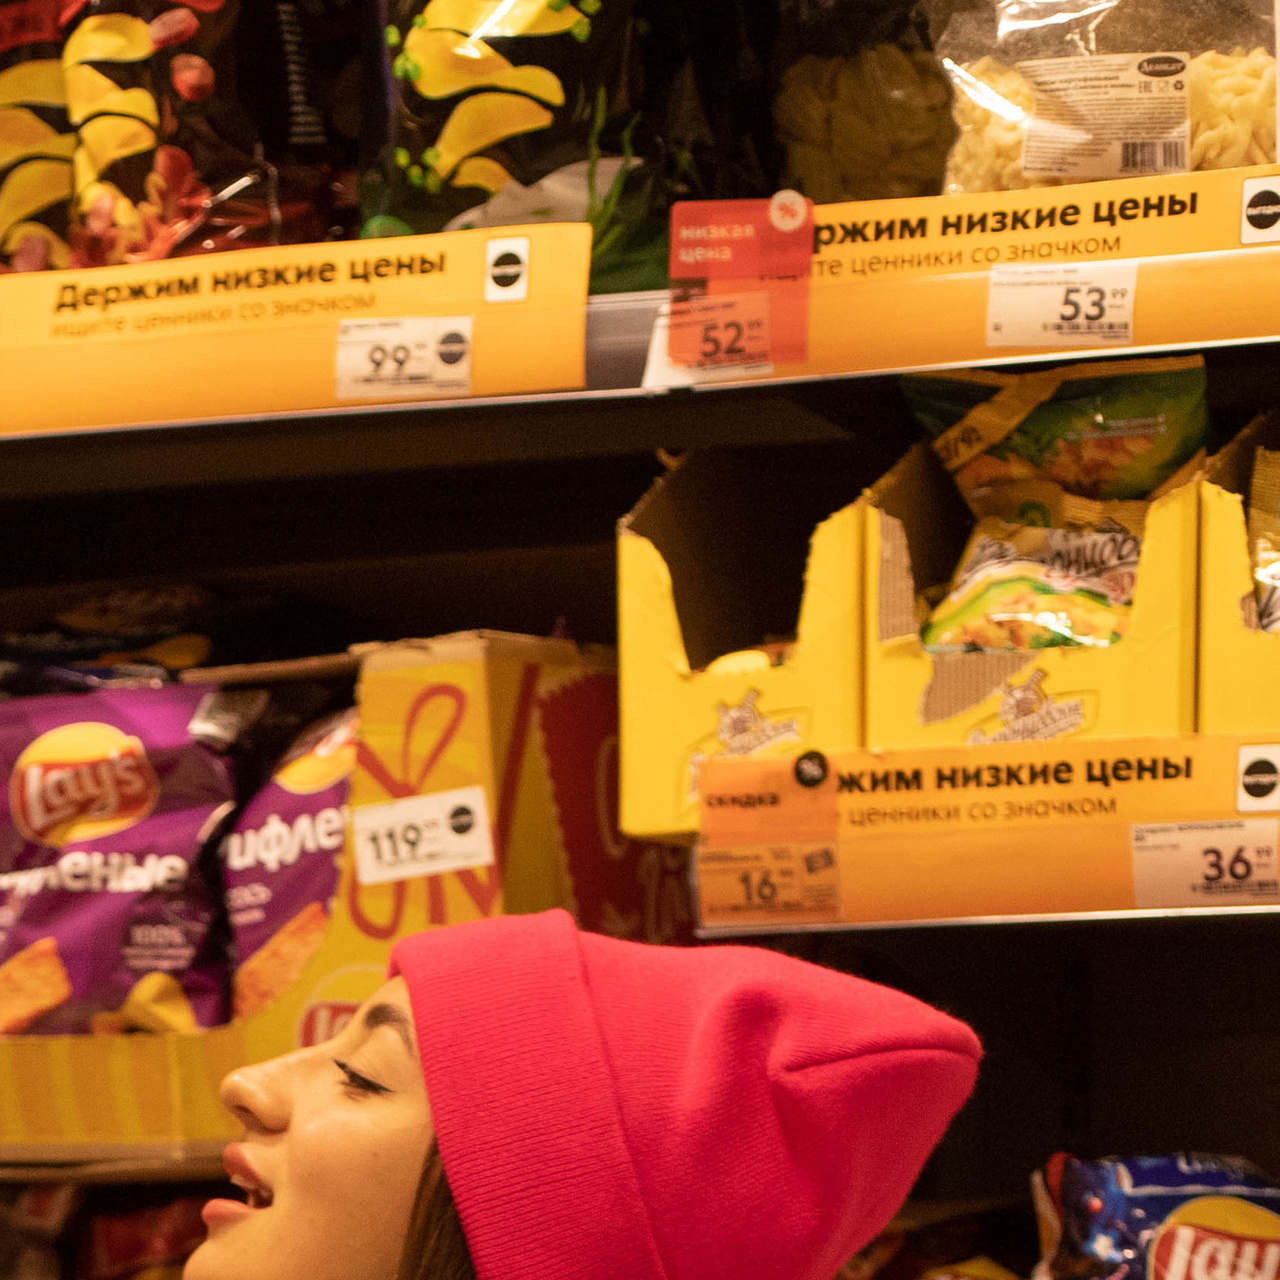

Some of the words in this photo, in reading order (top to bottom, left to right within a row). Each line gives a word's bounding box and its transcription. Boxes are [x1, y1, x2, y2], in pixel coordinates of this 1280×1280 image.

[813, 213, 928, 254] ржим
[940, 203, 1082, 238] низкие
[1092, 191, 1199, 225] цены
[851, 249, 964, 277] ценники
[971, 244, 1001, 264] со
[1007, 235, 1122, 262] значком
[54, 274, 200, 313] Держим
[211, 260, 337, 293] низкие
[351, 251, 446, 282] цены
[1059, 286, 1106, 321] 53
[369, 343, 410, 375] 99
[701, 321, 746, 359] 52
[24, 751, 145, 830] Lay's
[836, 768, 925, 794] жим
[936, 760, 1074, 790] низкие
[1084, 756, 1193, 787] цены
[368, 823, 422, 863] 119
[1202, 846, 1252, 882] 36
[739, 870, 778, 902] 16
